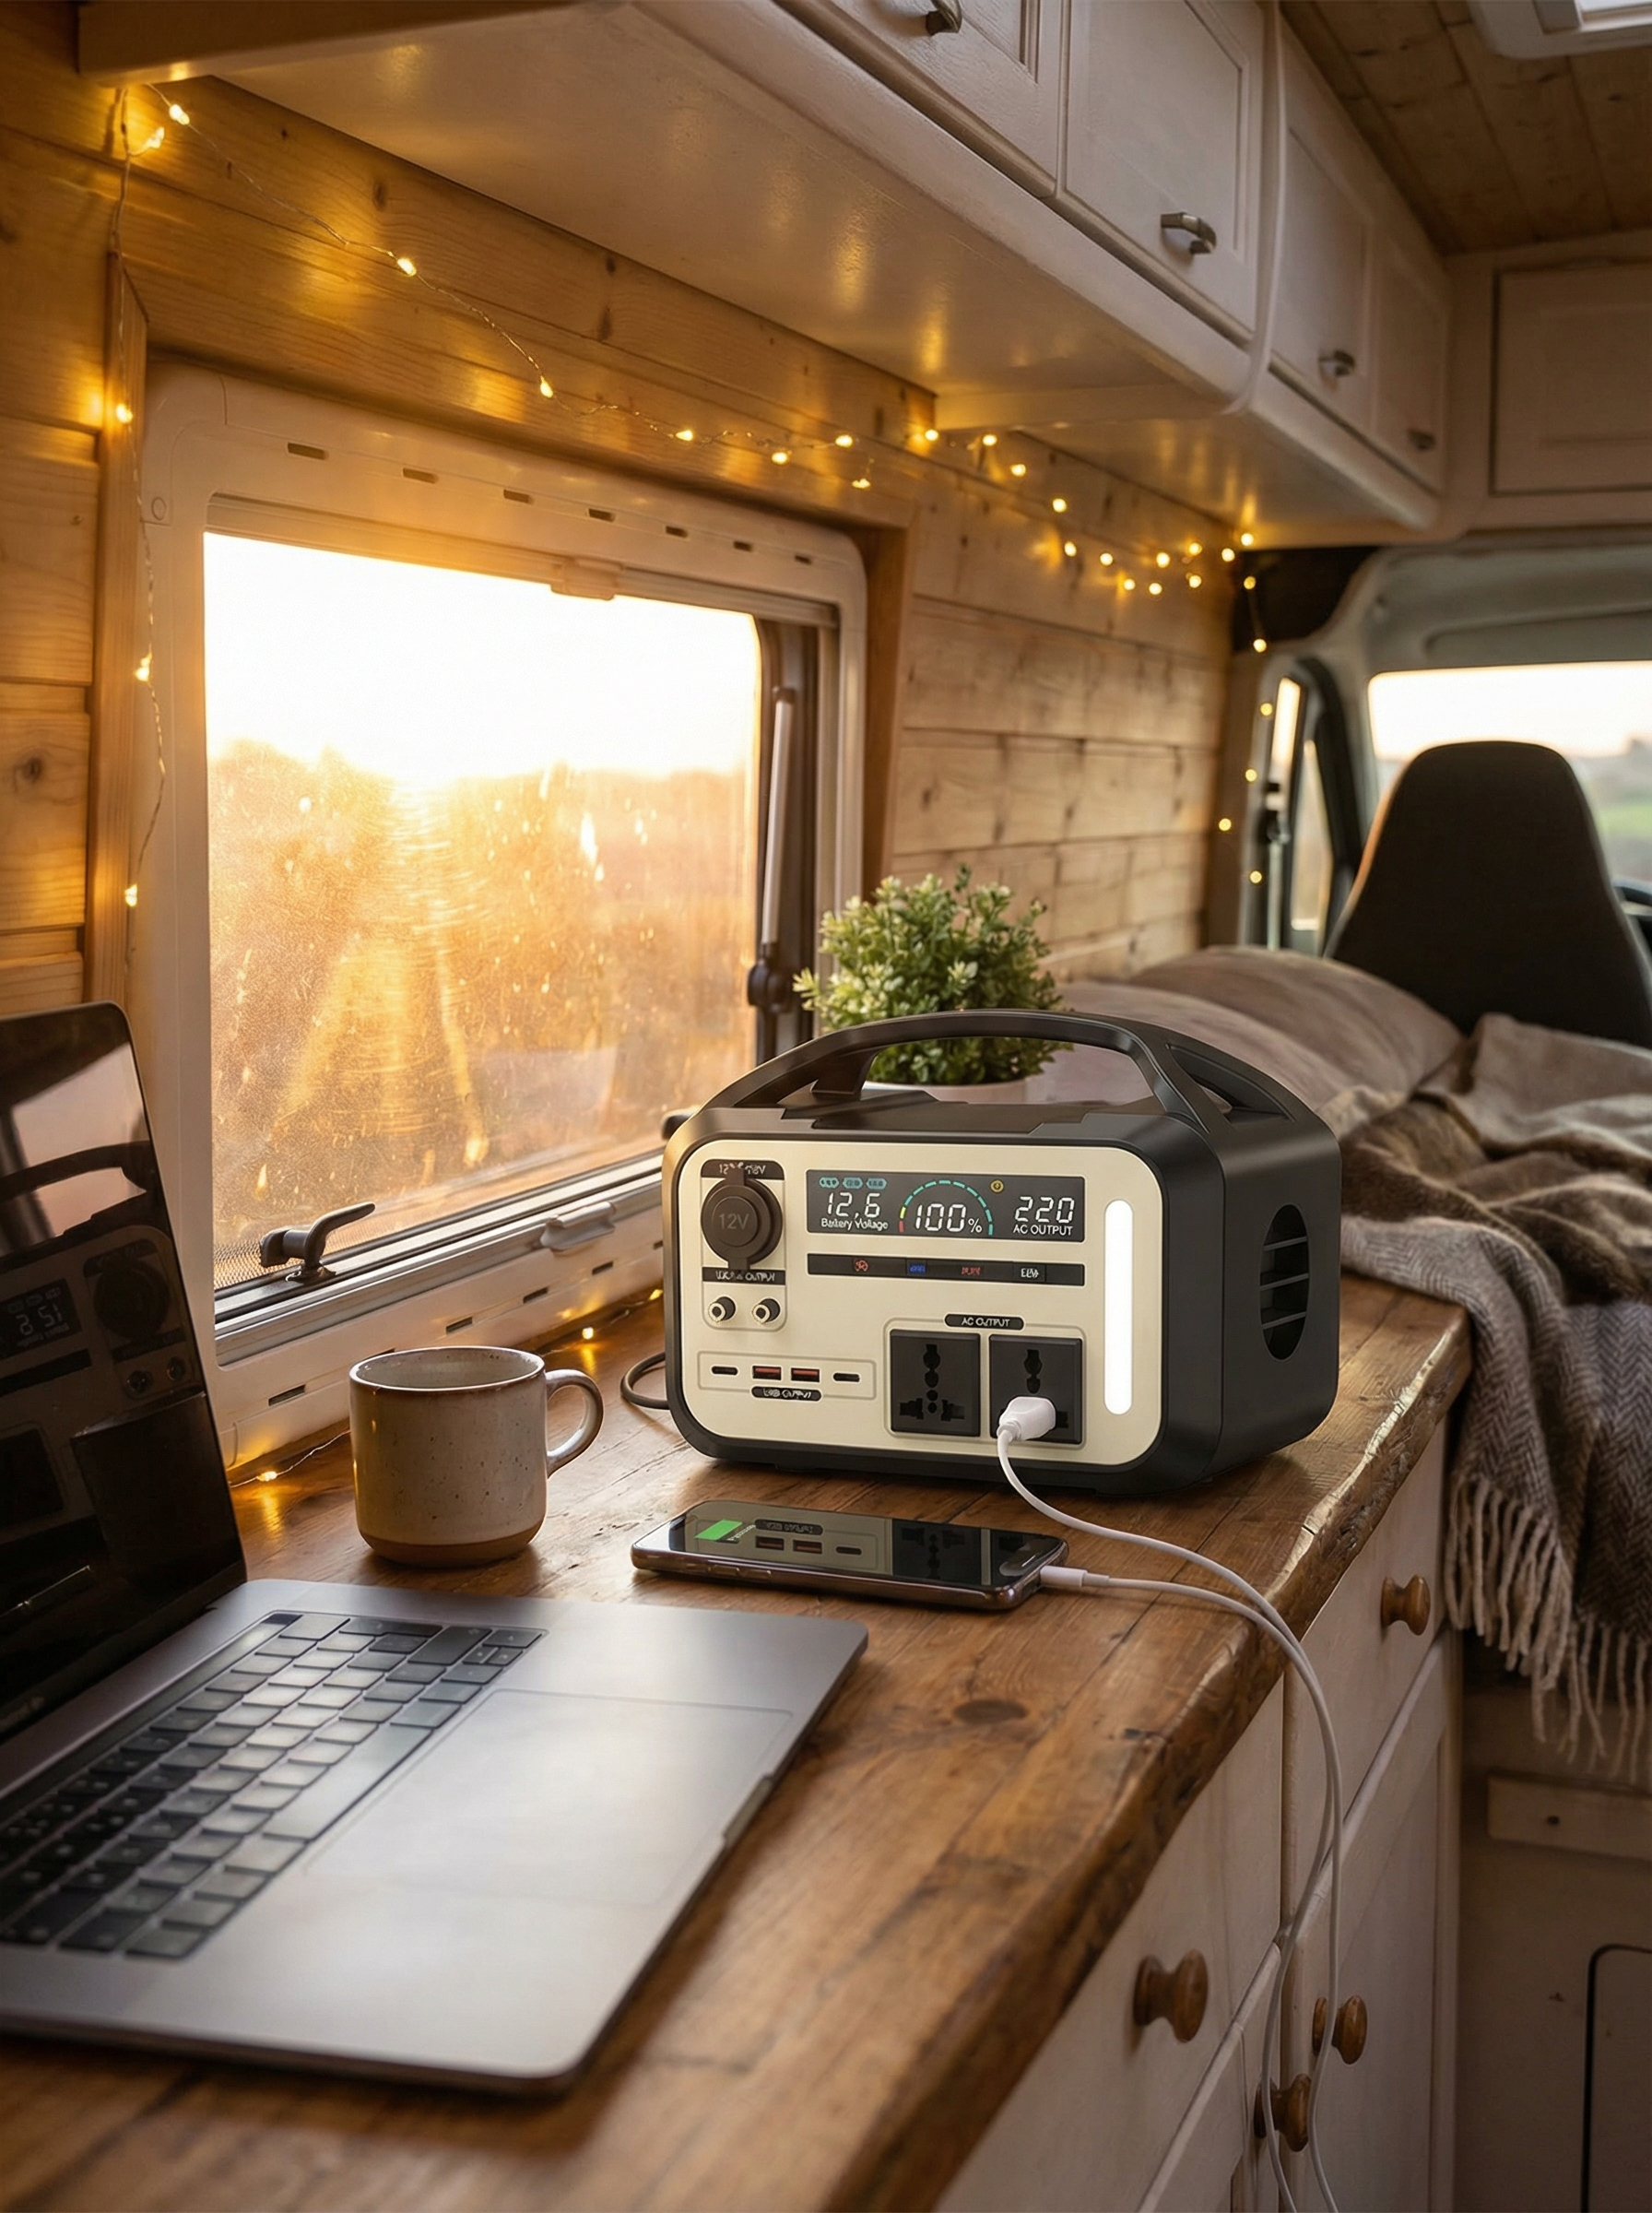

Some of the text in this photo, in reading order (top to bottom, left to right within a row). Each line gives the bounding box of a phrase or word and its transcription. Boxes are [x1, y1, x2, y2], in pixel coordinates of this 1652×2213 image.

[915, 1203, 983, 1233] 100%
[1014, 1196, 1075, 1224] 220
[719, 1213, 749, 1230] 12V
[1013, 1224, 1073, 1236] AC OUTPUT
[961, 1317, 974, 1326] AC
